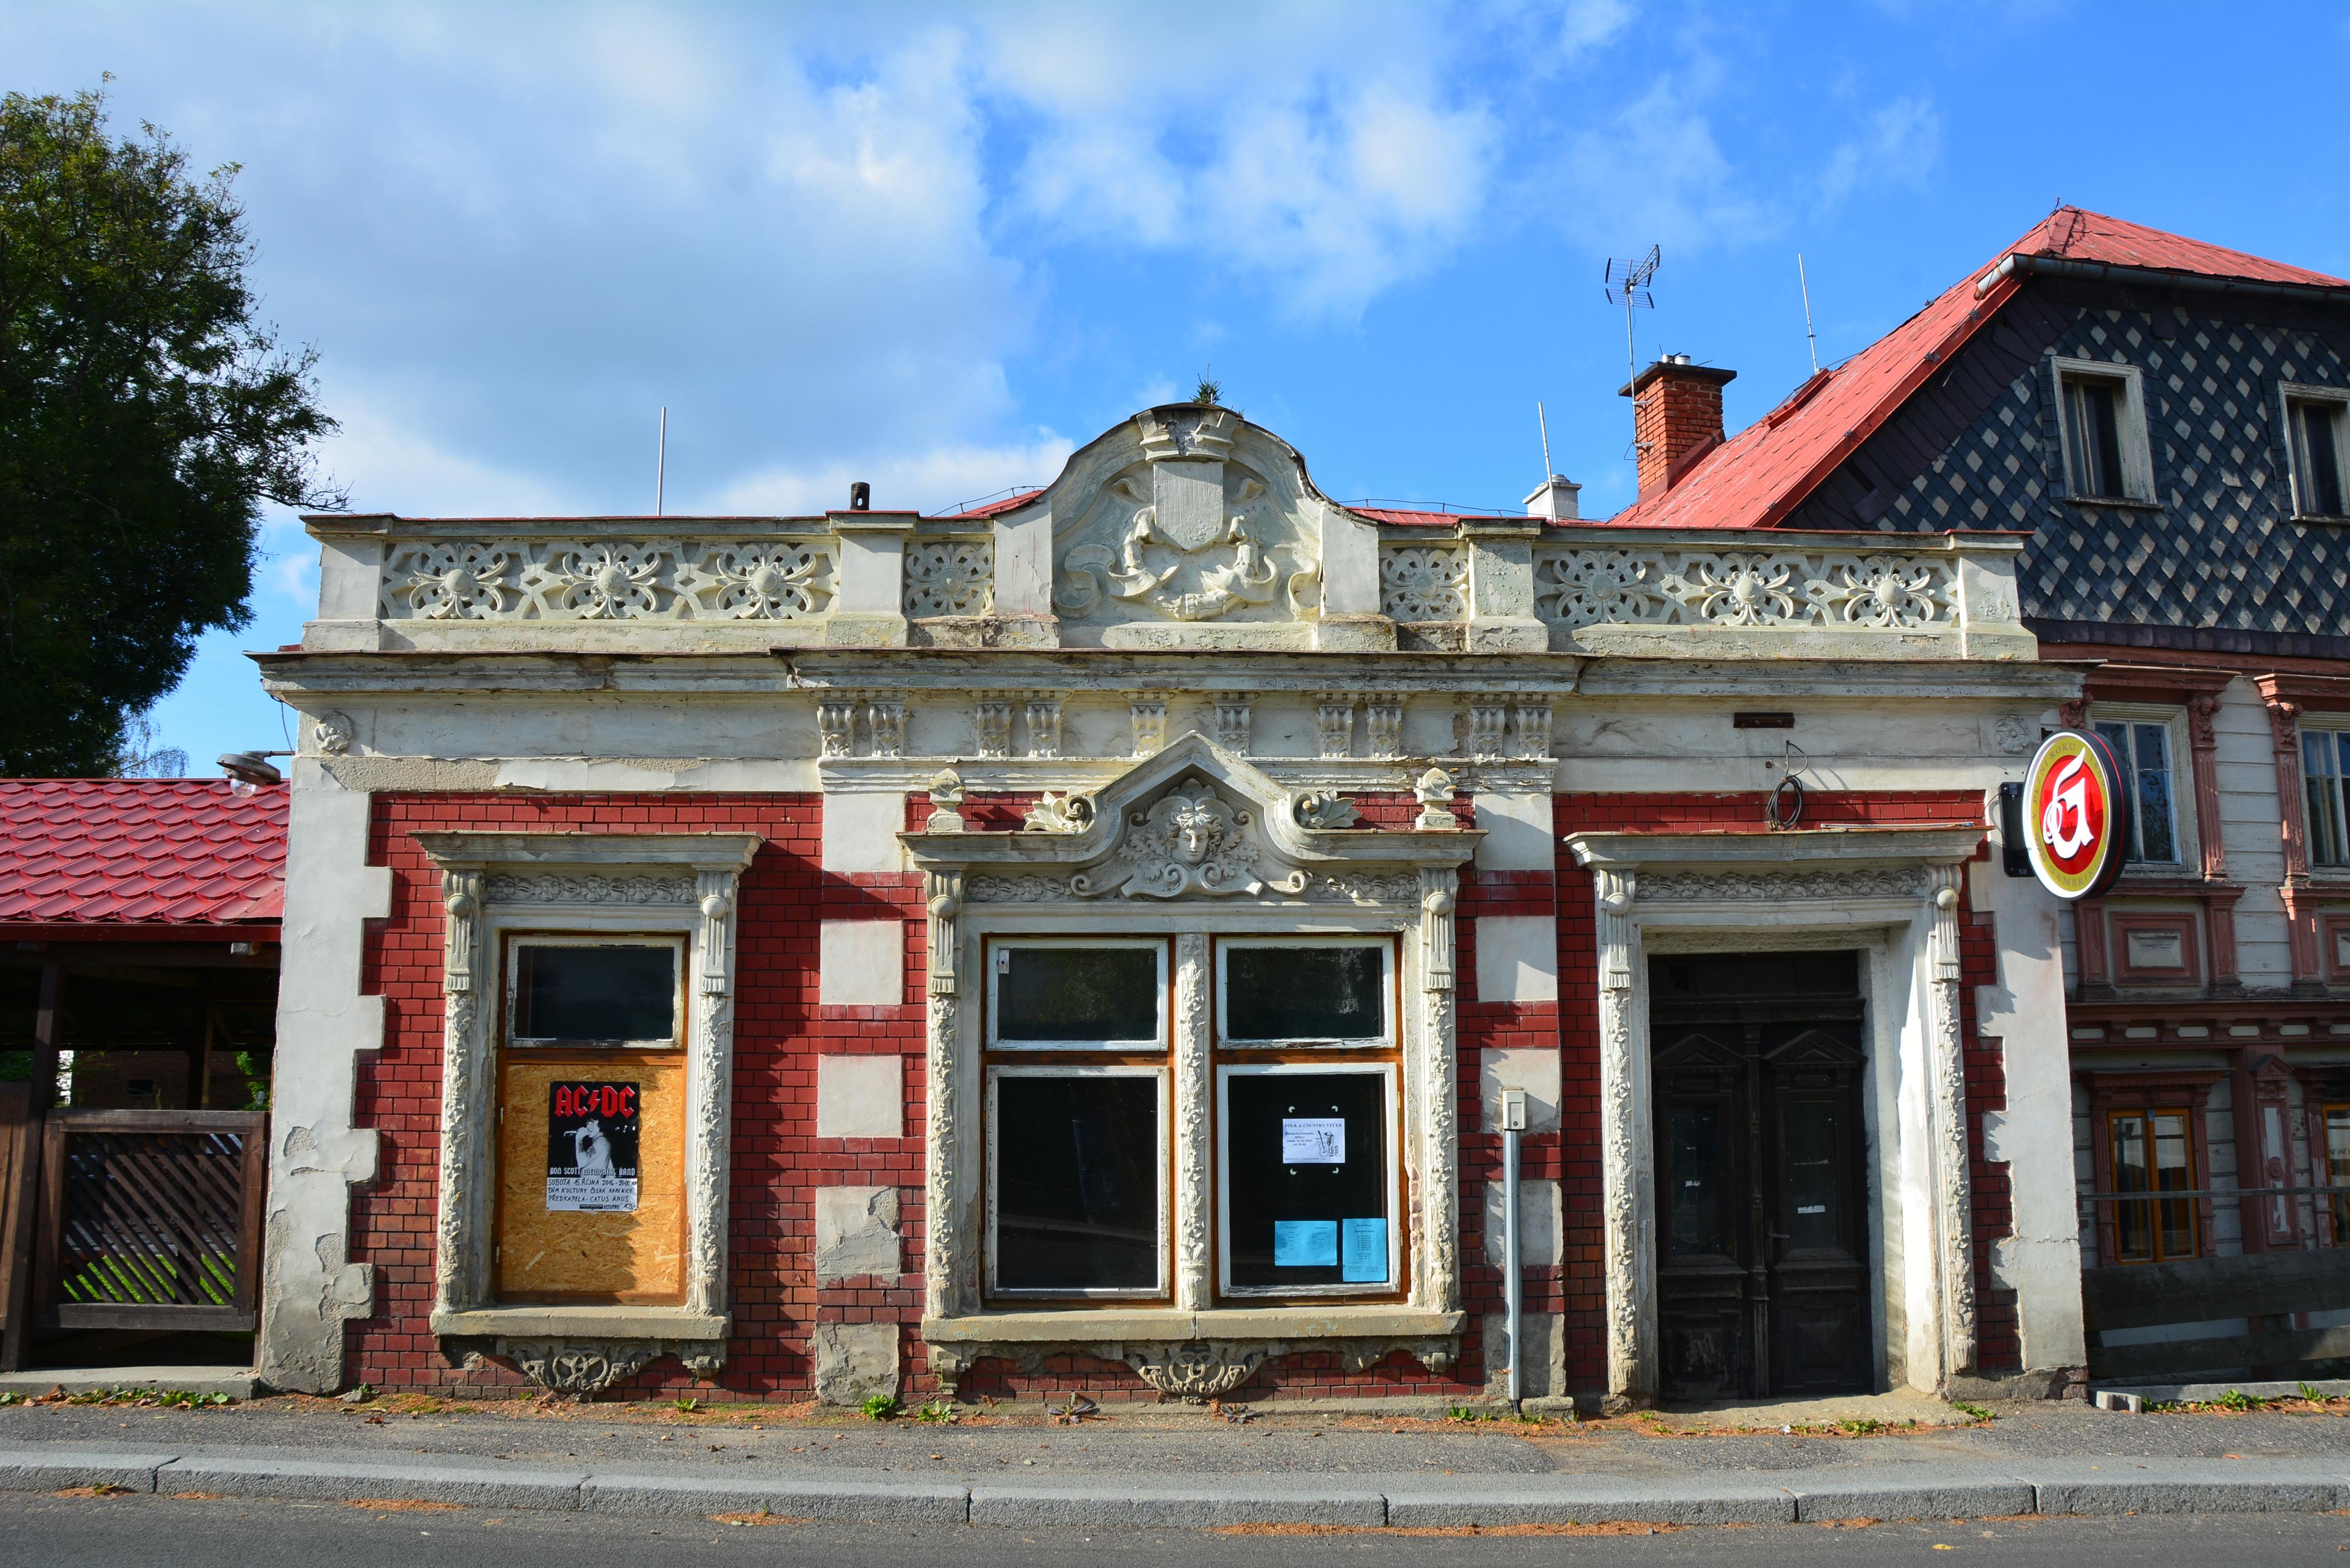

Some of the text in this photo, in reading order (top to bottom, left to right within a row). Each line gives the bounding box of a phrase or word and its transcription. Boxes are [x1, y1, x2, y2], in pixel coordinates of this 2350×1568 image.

[2050, 742, 2076, 761] ROKU
[564, 1167, 580, 1175] SCOTT
[583, 1168, 617, 1176] MEMORIAL
[619, 1167, 636, 1176] BAND
